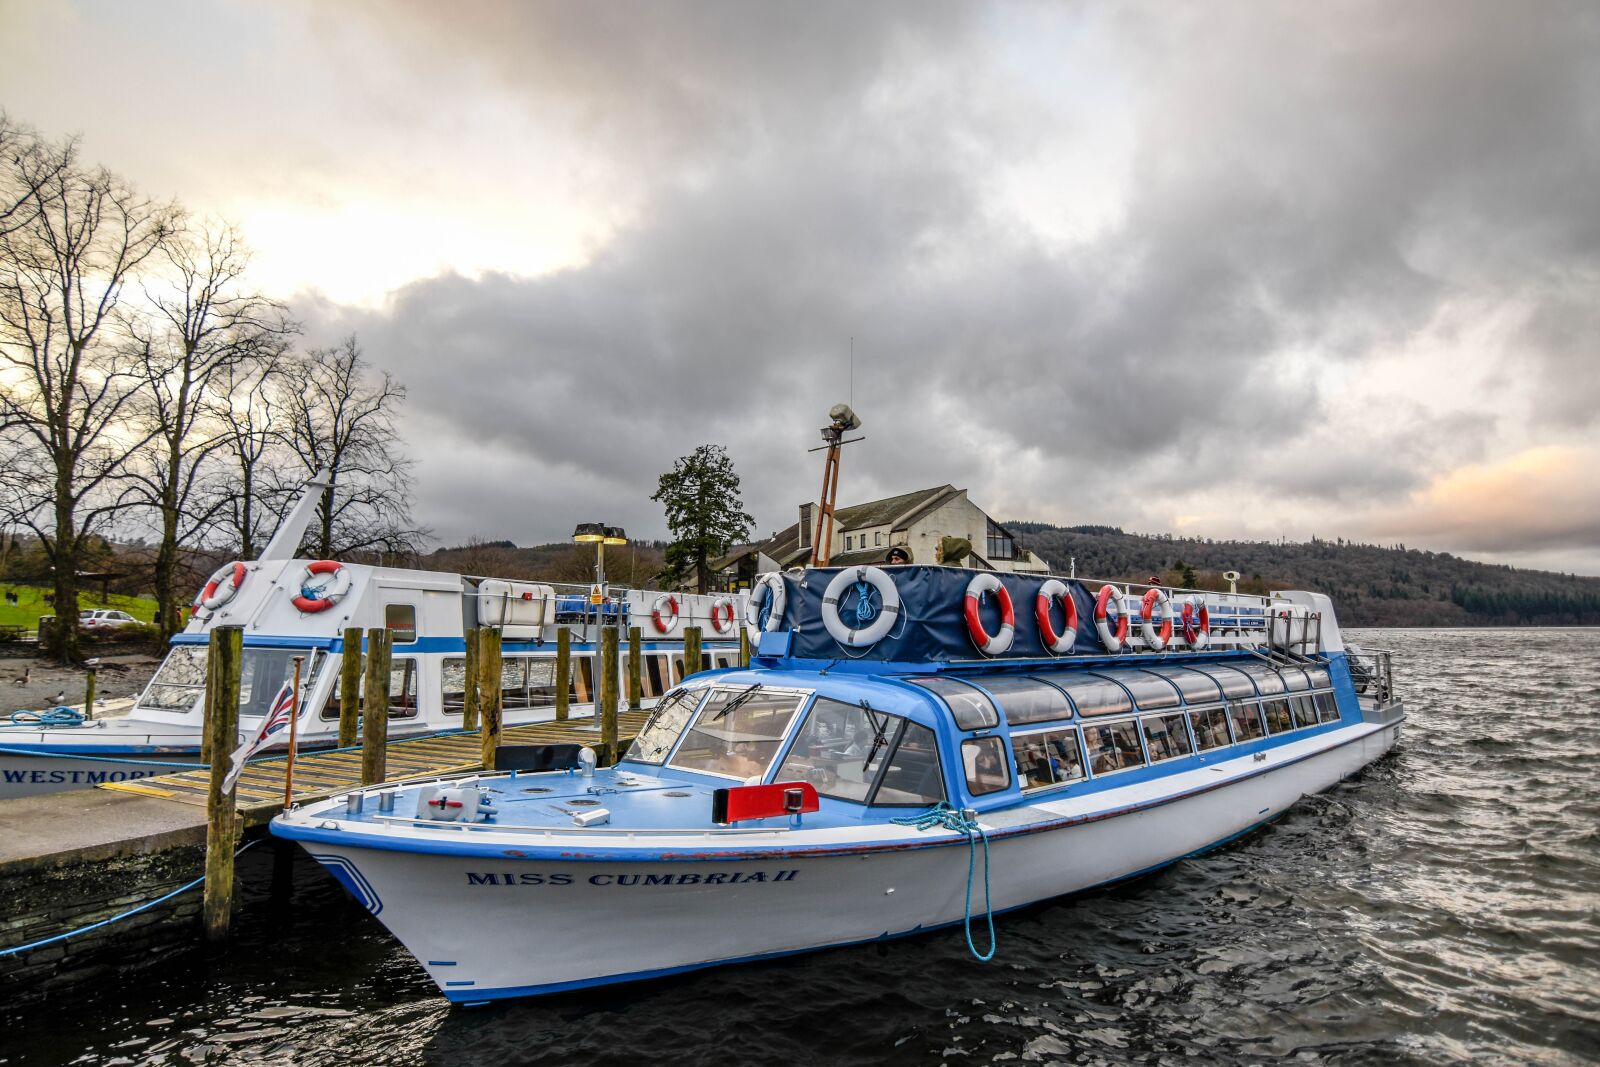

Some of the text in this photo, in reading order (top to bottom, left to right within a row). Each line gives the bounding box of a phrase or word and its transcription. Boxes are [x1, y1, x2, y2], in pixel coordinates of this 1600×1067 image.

[2, 770, 176, 784] WESTMOR
[465, 869, 800, 886] MISS CUMBRIA II
